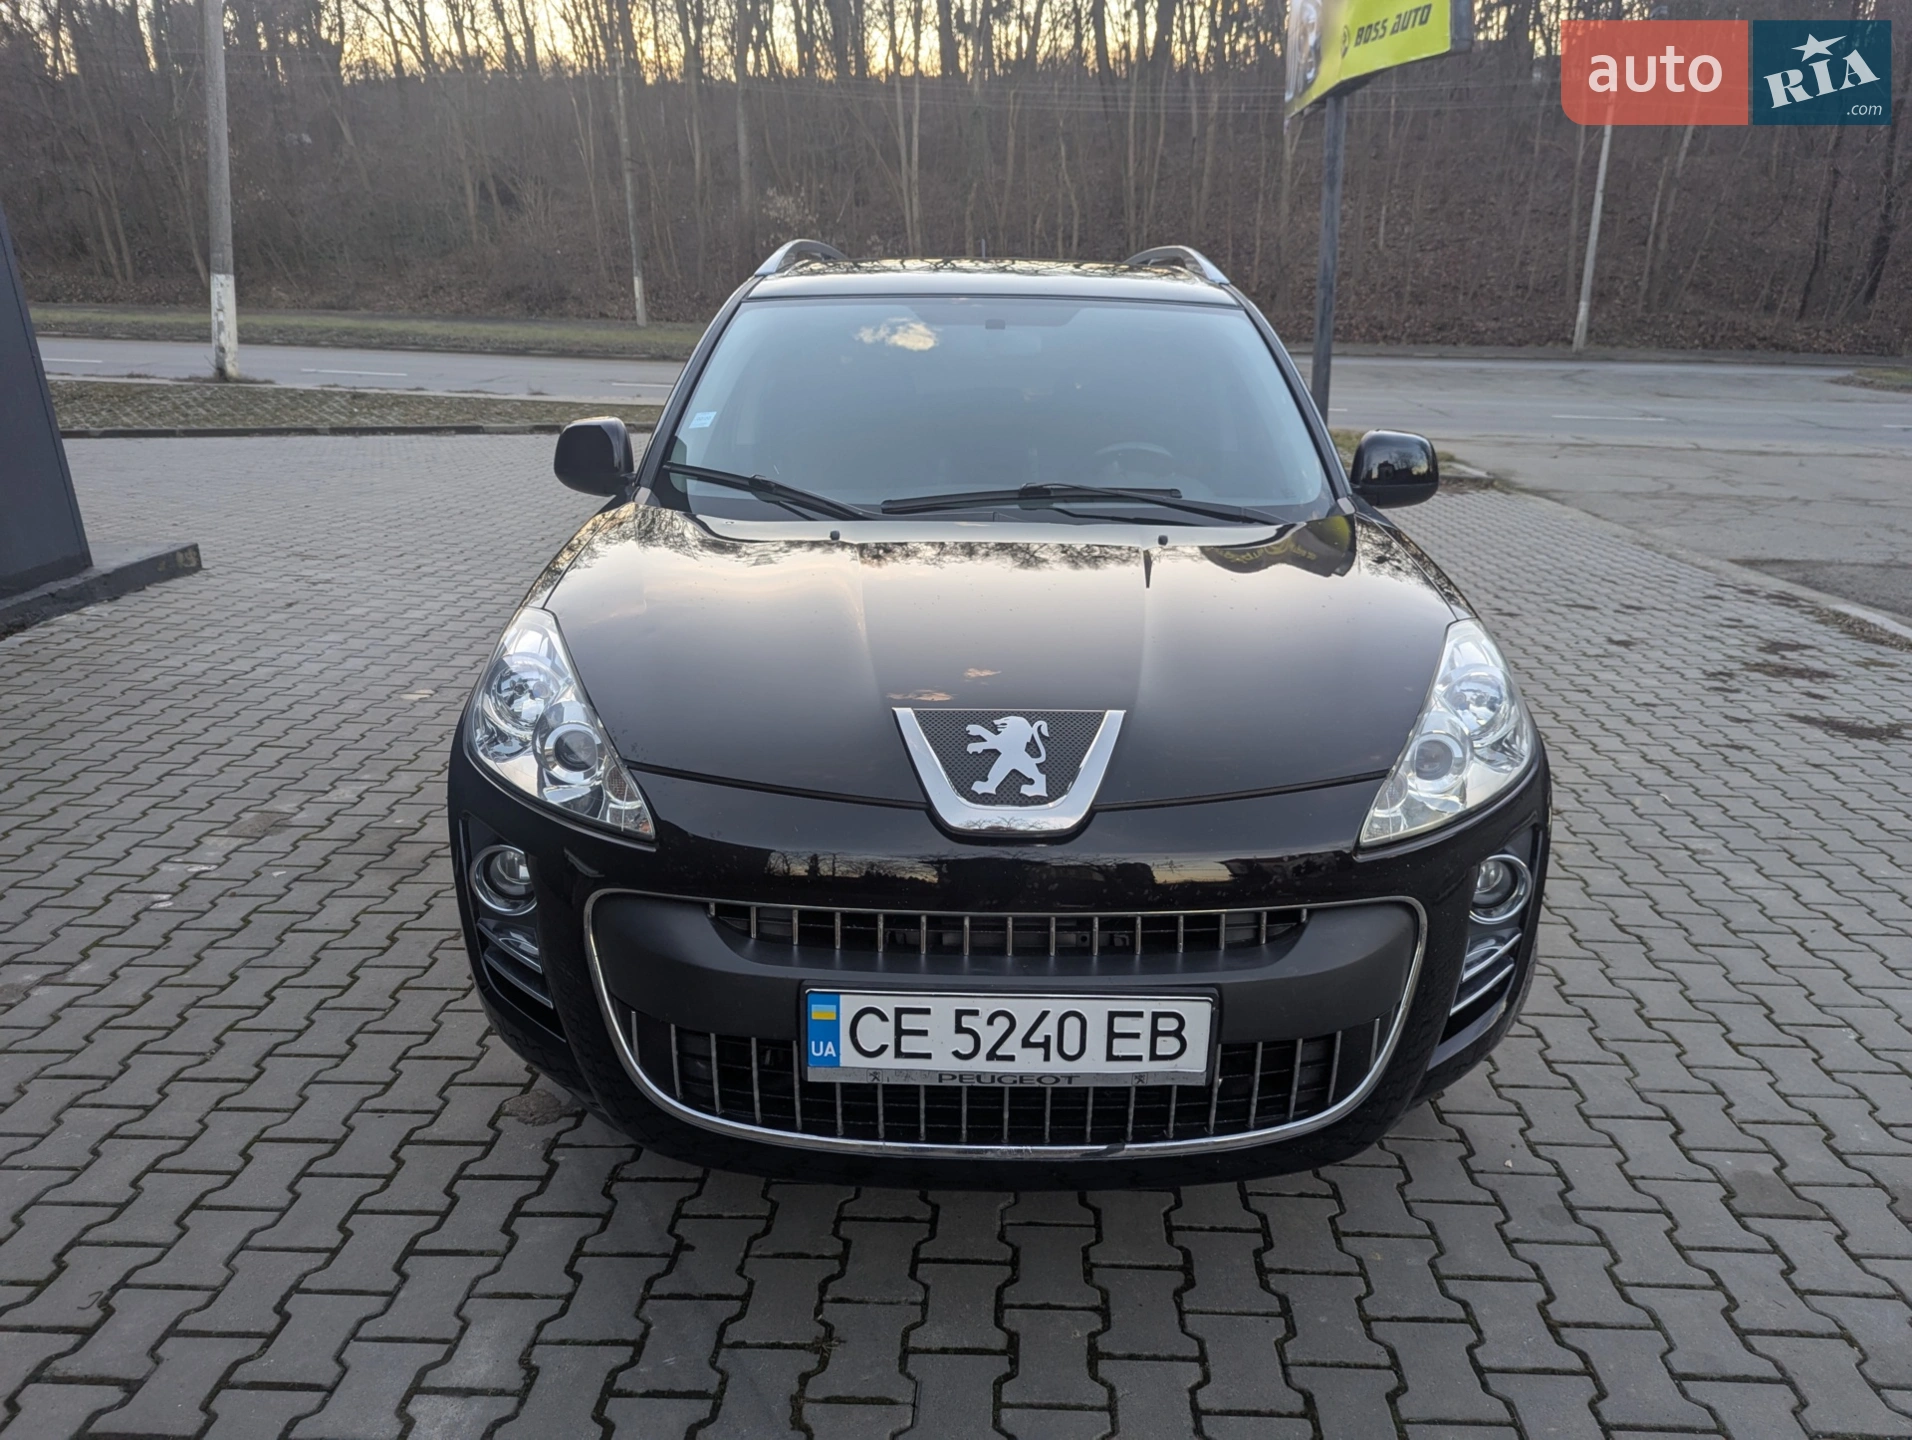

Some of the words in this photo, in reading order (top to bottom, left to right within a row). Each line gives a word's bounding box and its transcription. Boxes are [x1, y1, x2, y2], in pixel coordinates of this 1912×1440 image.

[1354, 18, 1389, 47] BOSS
[1390, 3, 1432, 36] AUTO
[849, 1006, 932, 1059] CE
[951, 1009, 1088, 1062] 5240
[1106, 1011, 1188, 1062] EB
[811, 1041, 837, 1058] UA
[938, 1073, 1080, 1086] PEUGEOT
